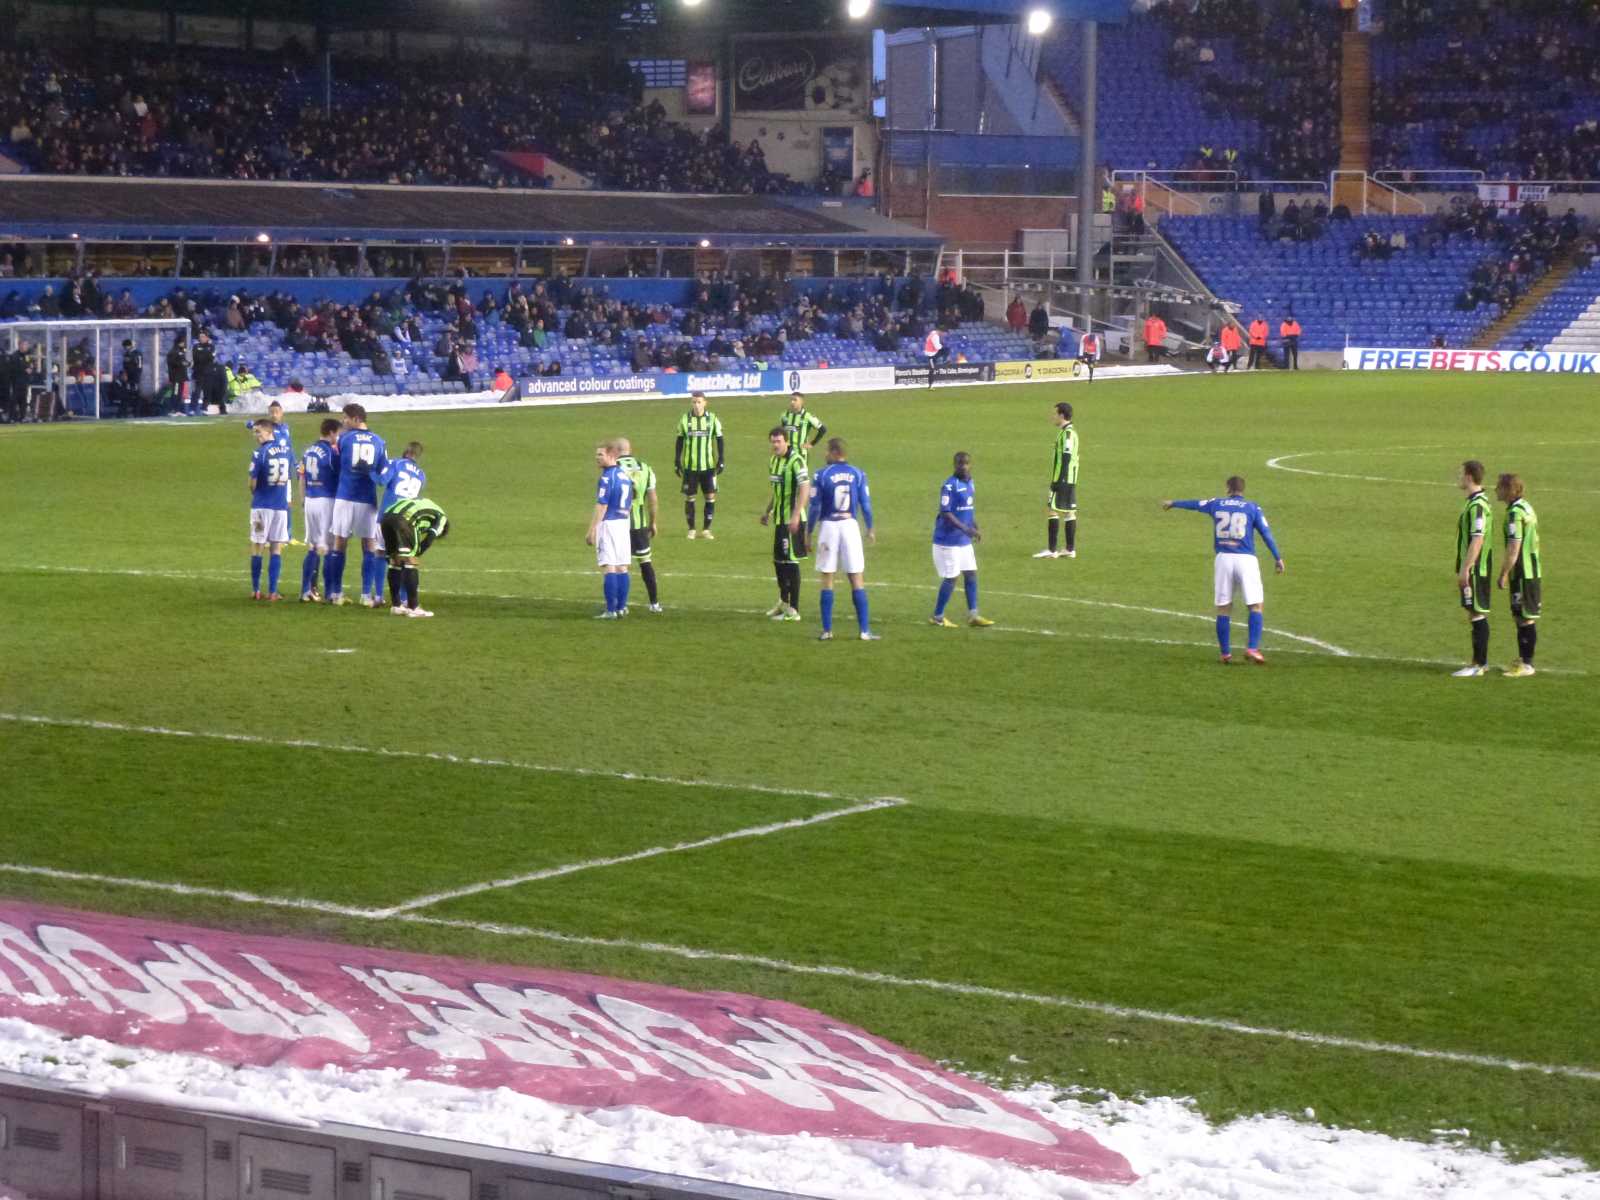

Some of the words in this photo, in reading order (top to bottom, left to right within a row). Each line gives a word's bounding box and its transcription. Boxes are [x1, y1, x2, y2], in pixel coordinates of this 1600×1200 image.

[1358, 350, 1598, 373] FREEBETS.CO.UK
[528, 378, 577, 394] advanced
[579, 377, 611, 392] colour
[613, 375, 656, 392] coatings
[743, 372, 761, 388] Ltd
[267, 457, 289, 483] 33
[306, 456, 319, 481] 4
[834, 485, 851, 511] 6
